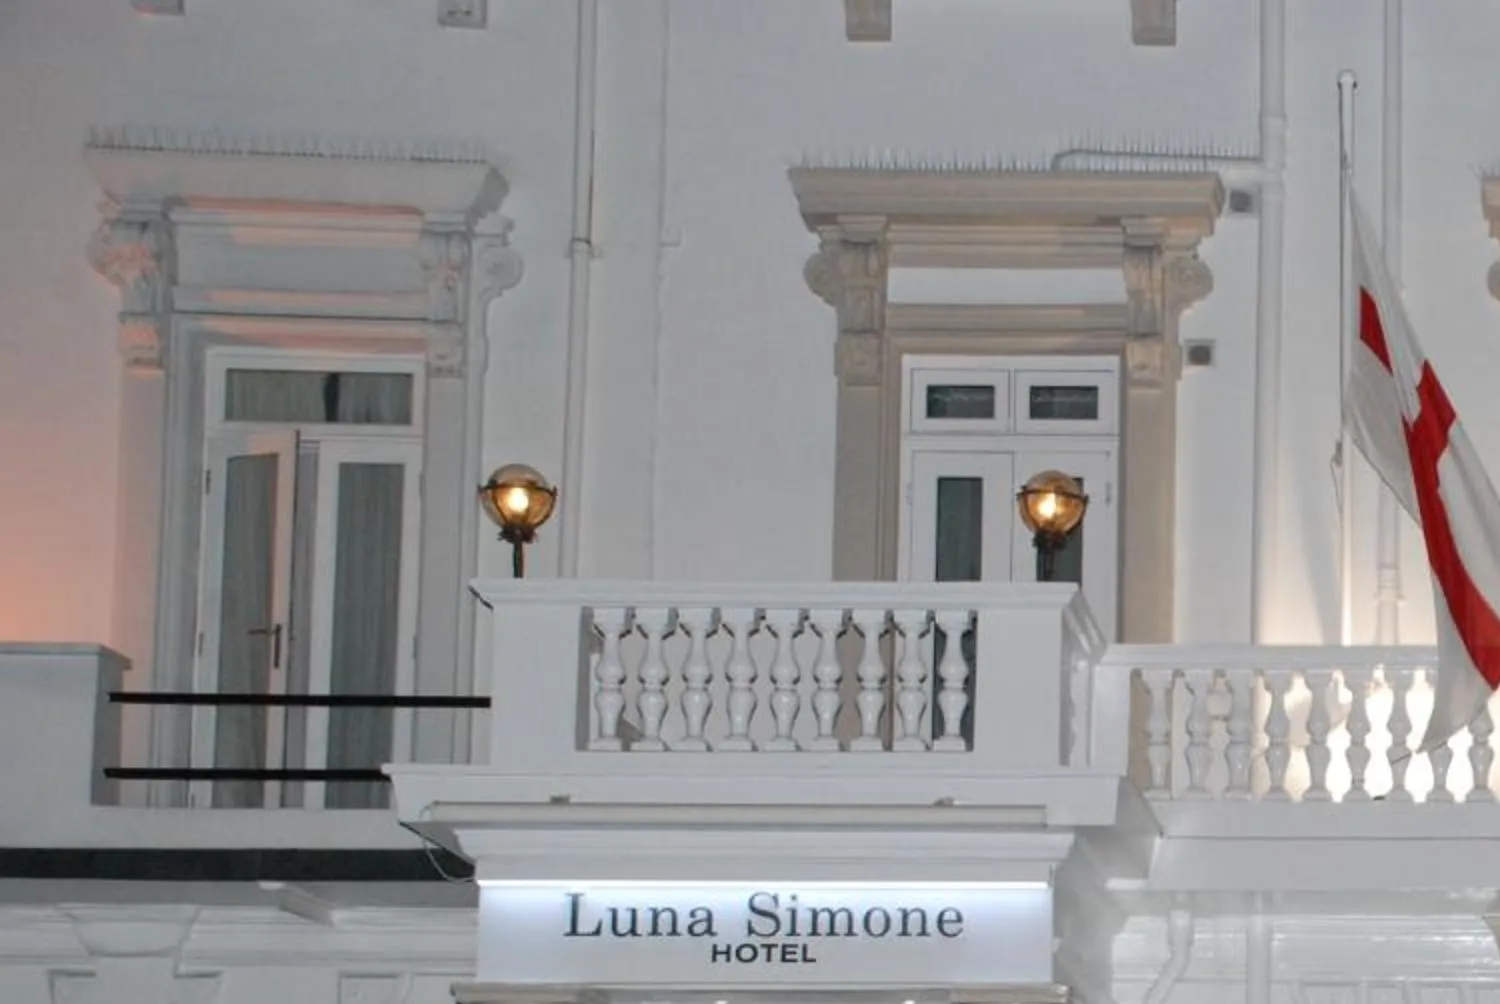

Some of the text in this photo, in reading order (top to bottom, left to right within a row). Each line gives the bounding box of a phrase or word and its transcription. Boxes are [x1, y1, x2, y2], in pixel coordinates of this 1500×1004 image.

[563, 890, 965, 938] Luna Simone
[711, 943, 817, 963] HOTEL
